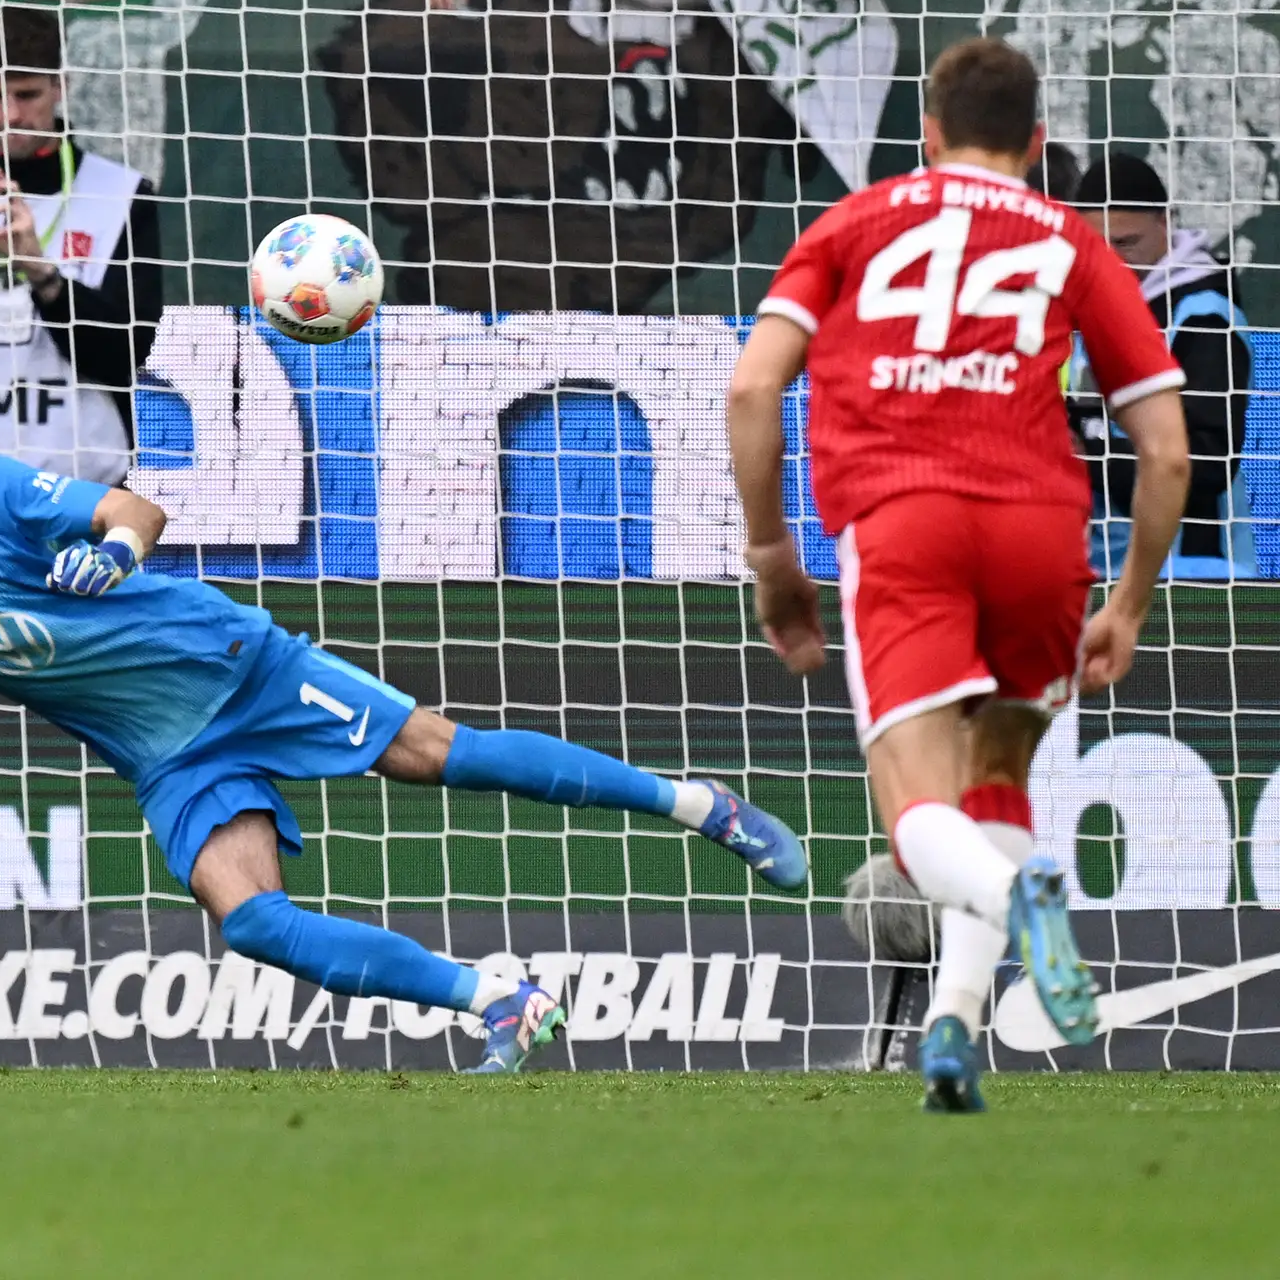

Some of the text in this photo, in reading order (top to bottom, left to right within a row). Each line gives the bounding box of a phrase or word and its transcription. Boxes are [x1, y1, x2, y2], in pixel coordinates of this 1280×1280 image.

[890, 181, 1066, 234] FC BAYERN
[856, 204, 1078, 358] 44
[299, 680, 356, 723] 1
